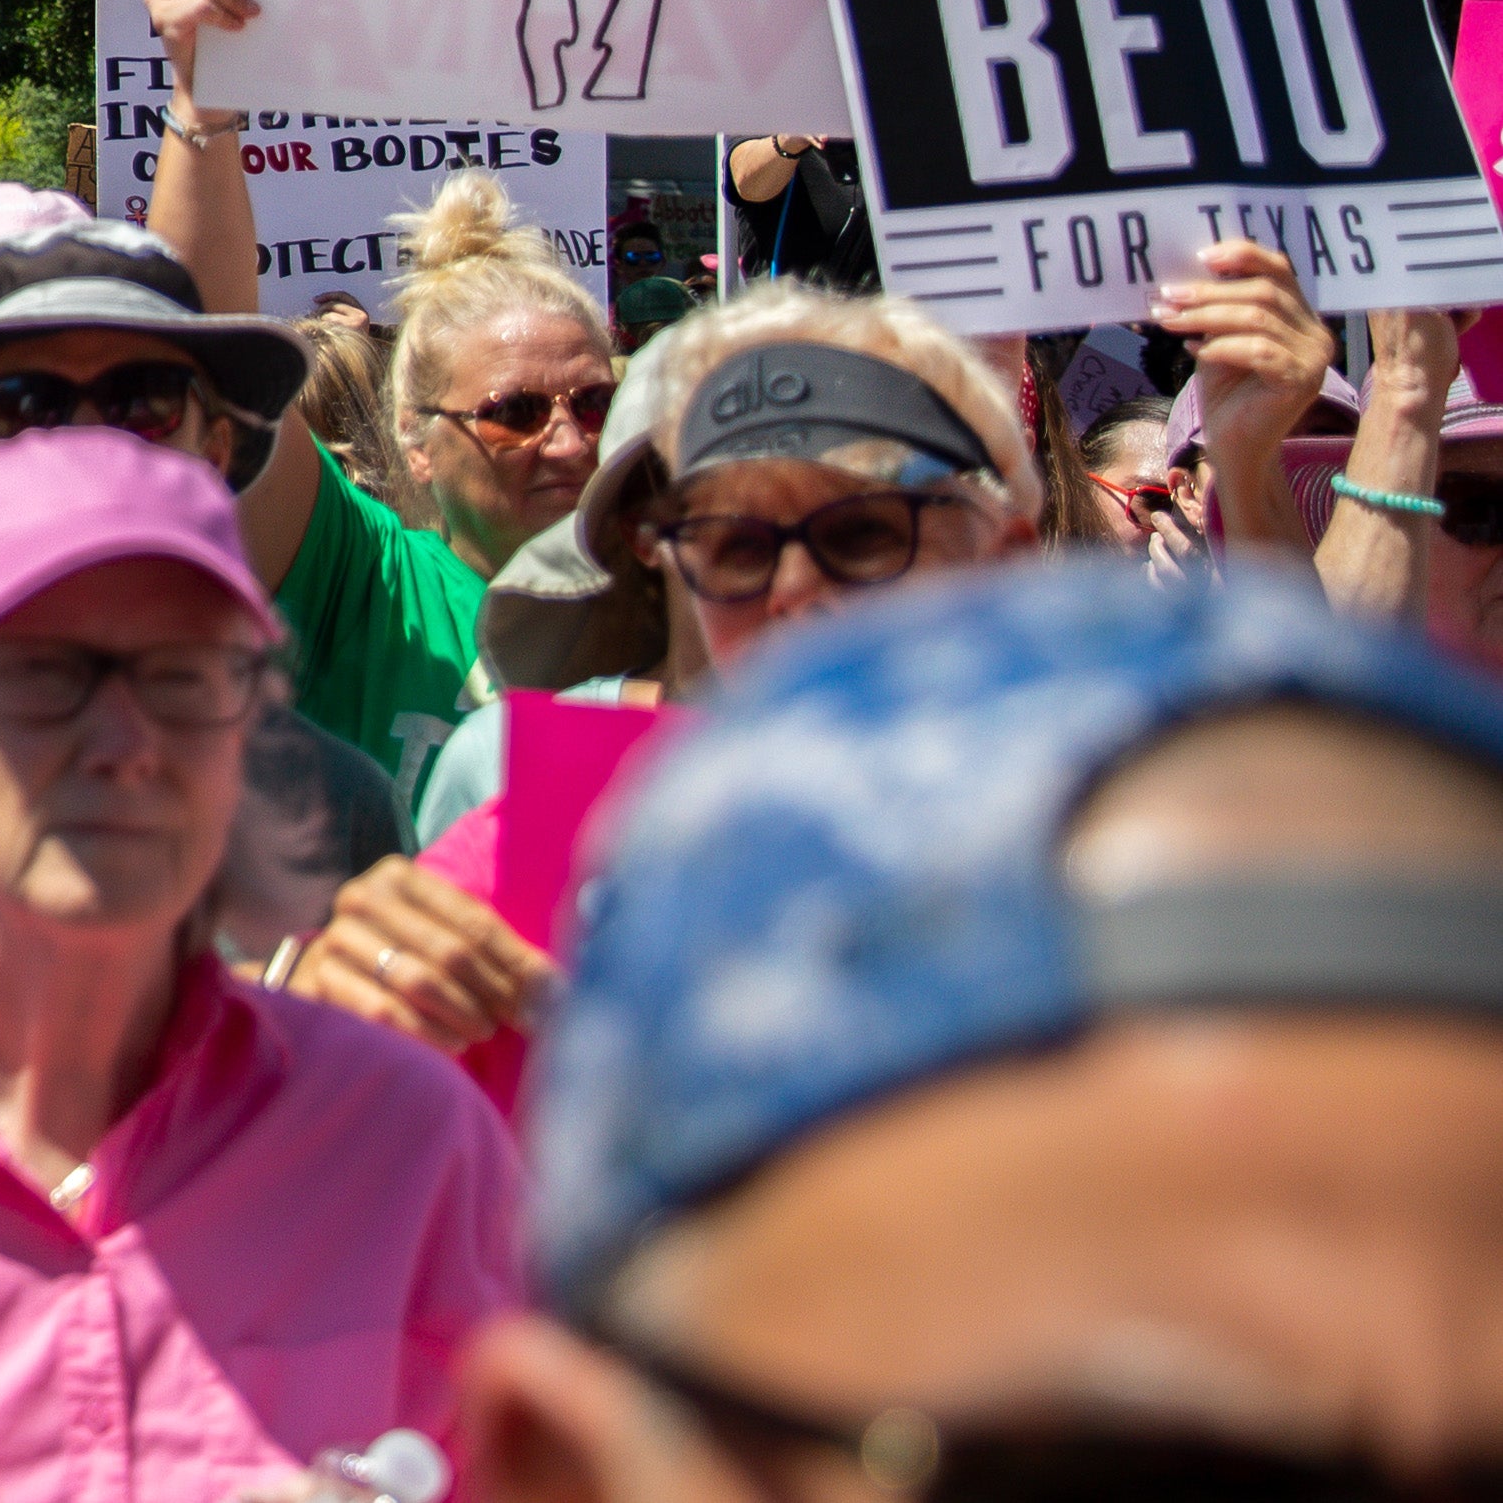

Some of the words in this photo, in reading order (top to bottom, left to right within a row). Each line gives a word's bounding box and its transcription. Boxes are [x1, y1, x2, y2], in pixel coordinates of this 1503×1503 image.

[331, 127, 562, 173] BODIES
[256, 232, 395, 279] OTECT
[1022, 210, 1154, 292] FOR
[710, 351, 813, 424] alo
